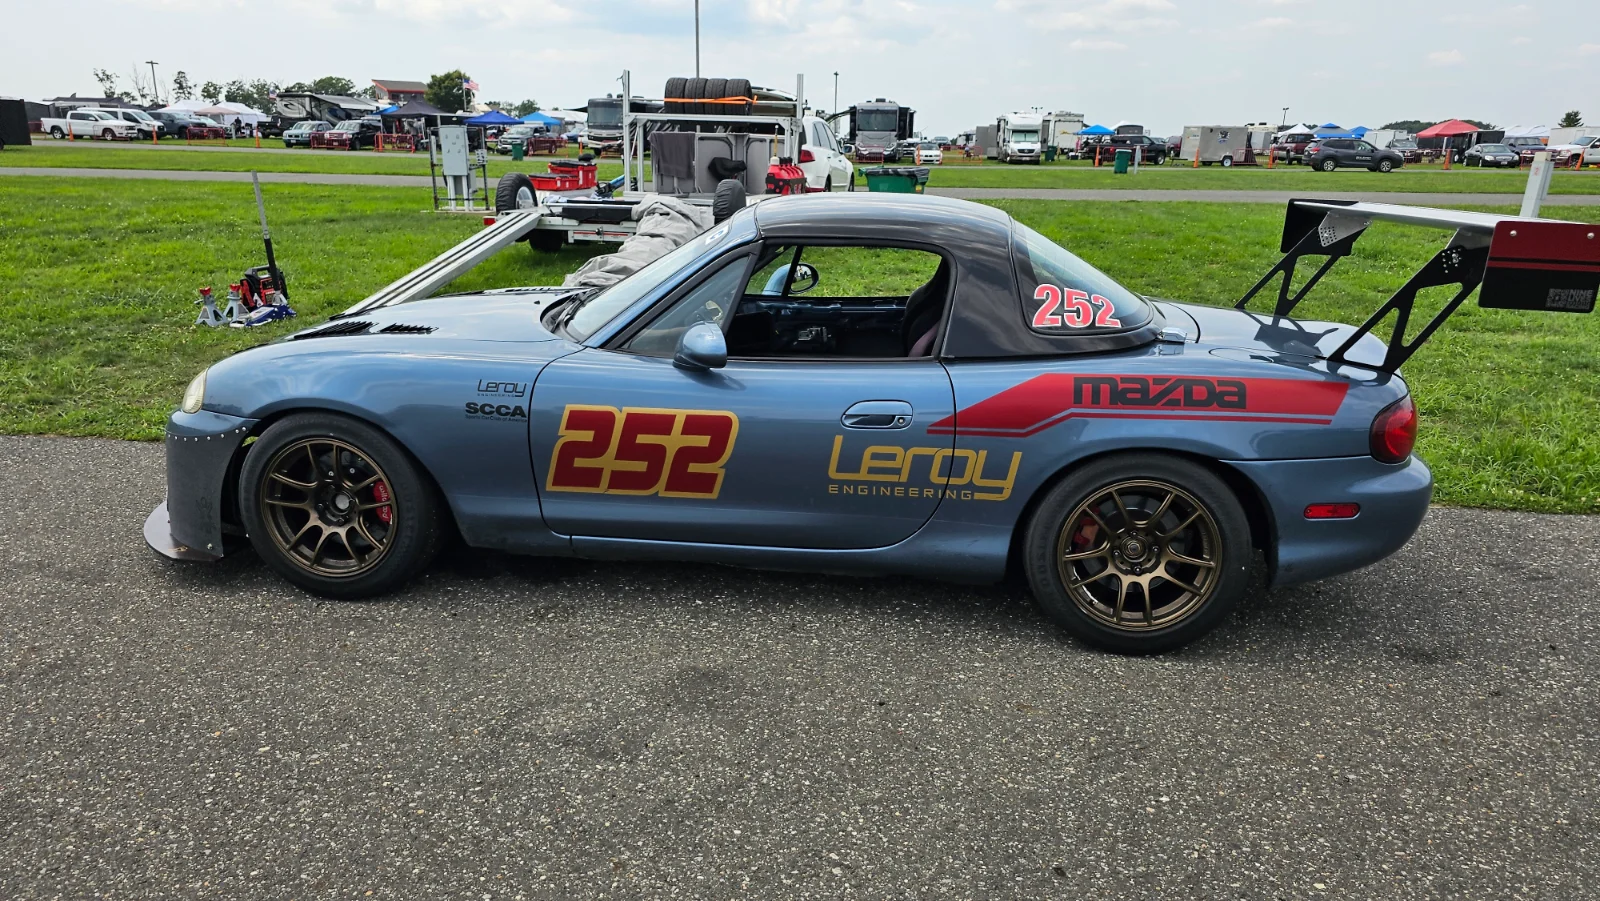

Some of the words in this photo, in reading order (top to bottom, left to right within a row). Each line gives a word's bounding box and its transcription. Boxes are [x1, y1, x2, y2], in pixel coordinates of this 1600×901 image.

[1032, 283, 1121, 328] 252
[477, 379, 527, 398] Leroy
[465, 401, 527, 418] SCCA
[546, 403, 740, 500] 252
[828, 434, 1023, 501] Leroy
[828, 484, 972, 501] ENGINEERING
